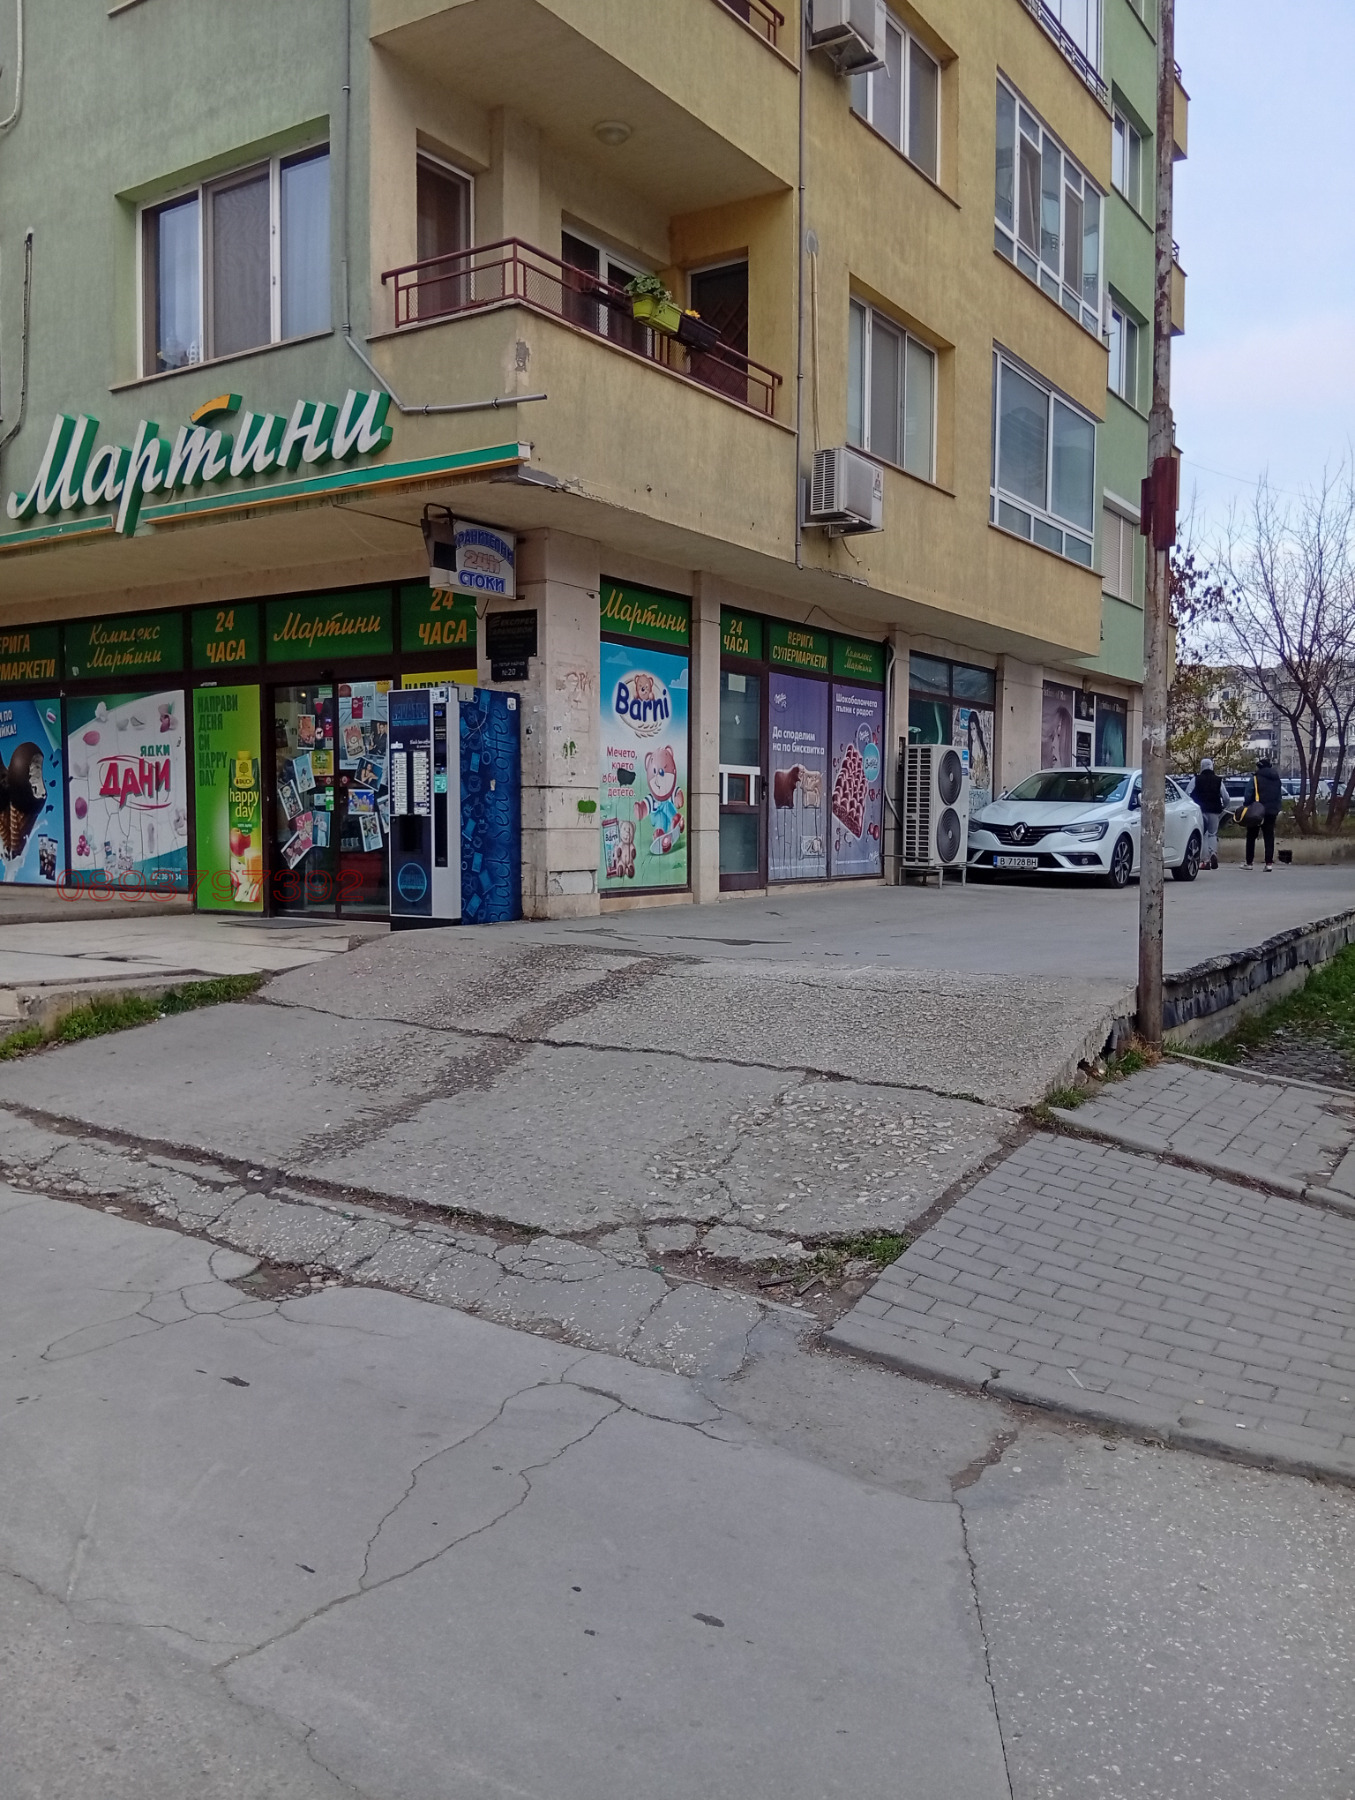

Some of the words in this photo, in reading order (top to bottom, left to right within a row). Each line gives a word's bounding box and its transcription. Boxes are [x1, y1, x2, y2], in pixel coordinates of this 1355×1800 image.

[7, 389, 392, 536] Мартини
[458, 570, 506, 593] СТОКИ
[430, 588, 454, 611] 24
[600, 588, 687, 633] Мартини
[215, 611, 235, 633] 24
[273, 612, 380, 647] Мартини
[730, 619, 743, 635] 24
[89, 624, 160, 645] Комплекс
[418, 619, 467, 645] ЧАСА
[788, 631, 814, 649] ВЕРИГА
[207, 639, 246, 663] ЧАСА
[724, 635, 749, 654] ЧАСА
[87, 645, 161, 672] Мартини
[772, 645, 827, 669] СУПЕРМАРКЕТИ
[0, 658, 55, 681] МАРКЕТИ
[198, 694, 238, 713] НАПРАВИ
[615, 681, 670, 722] Barni
[0, 723, 17, 737] ЙКА!
[199, 713, 223, 733] ДЕНЯ
[199, 734, 210, 751] СИ
[772, 726, 783, 740] Да
[783, 730, 816, 742] споделим
[140, 744, 170, 757] ЯДКИ
[607, 746, 638, 759] Мечето,
[772, 742, 782, 751] на
[783, 743, 790, 752] по
[791, 742, 825, 755] бисквитка
[199, 752, 227, 768] HAPPY
[611, 761, 634, 771] което
[99, 758, 171, 809] ДАНИ
[607, 787, 636, 798] детето.
[230, 787, 259, 806] happy
[235, 803, 254, 821] day
[1008, 858, 1026, 866] 7128
